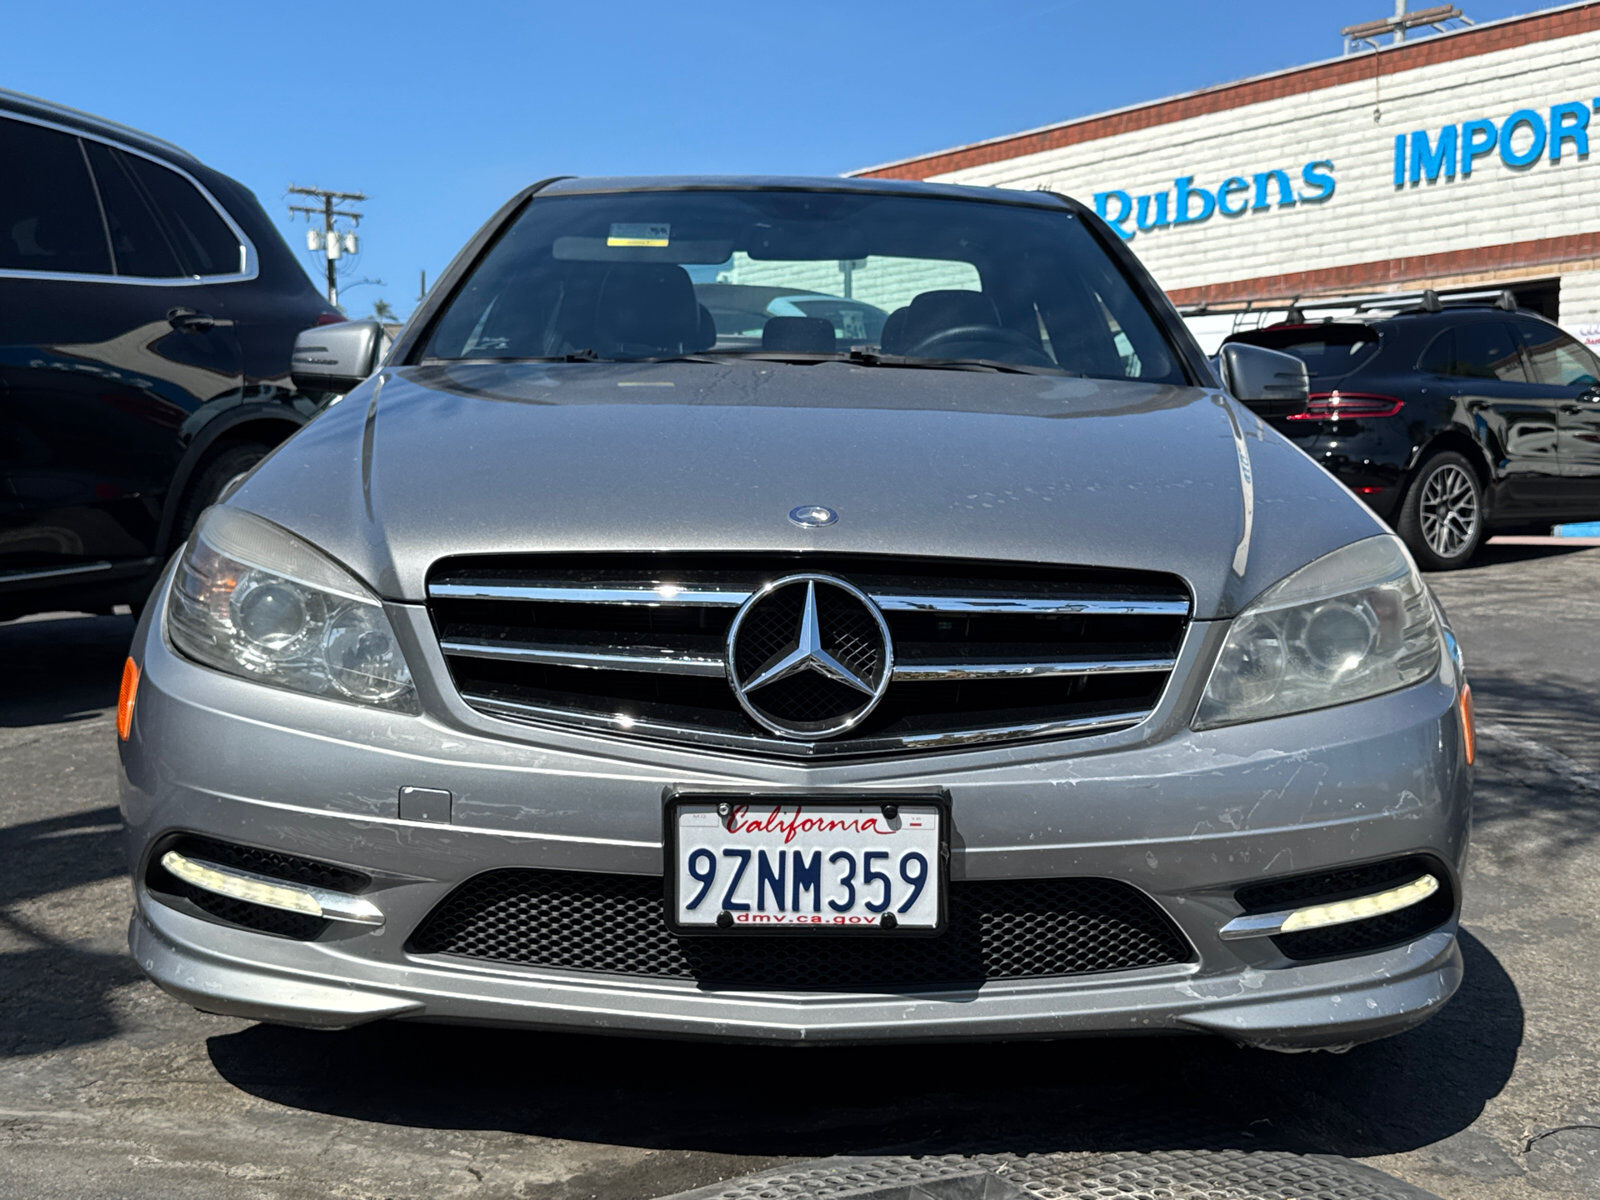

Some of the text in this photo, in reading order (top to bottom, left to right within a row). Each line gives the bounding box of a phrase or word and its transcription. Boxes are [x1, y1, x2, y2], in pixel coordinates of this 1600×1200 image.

[1093, 97, 1600, 241] Rubens IMPOR
[726, 805, 897, 844] California
[685, 848, 928, 913] 9ZNM359
[736, 912, 876, 924] dmv.ca.gov
